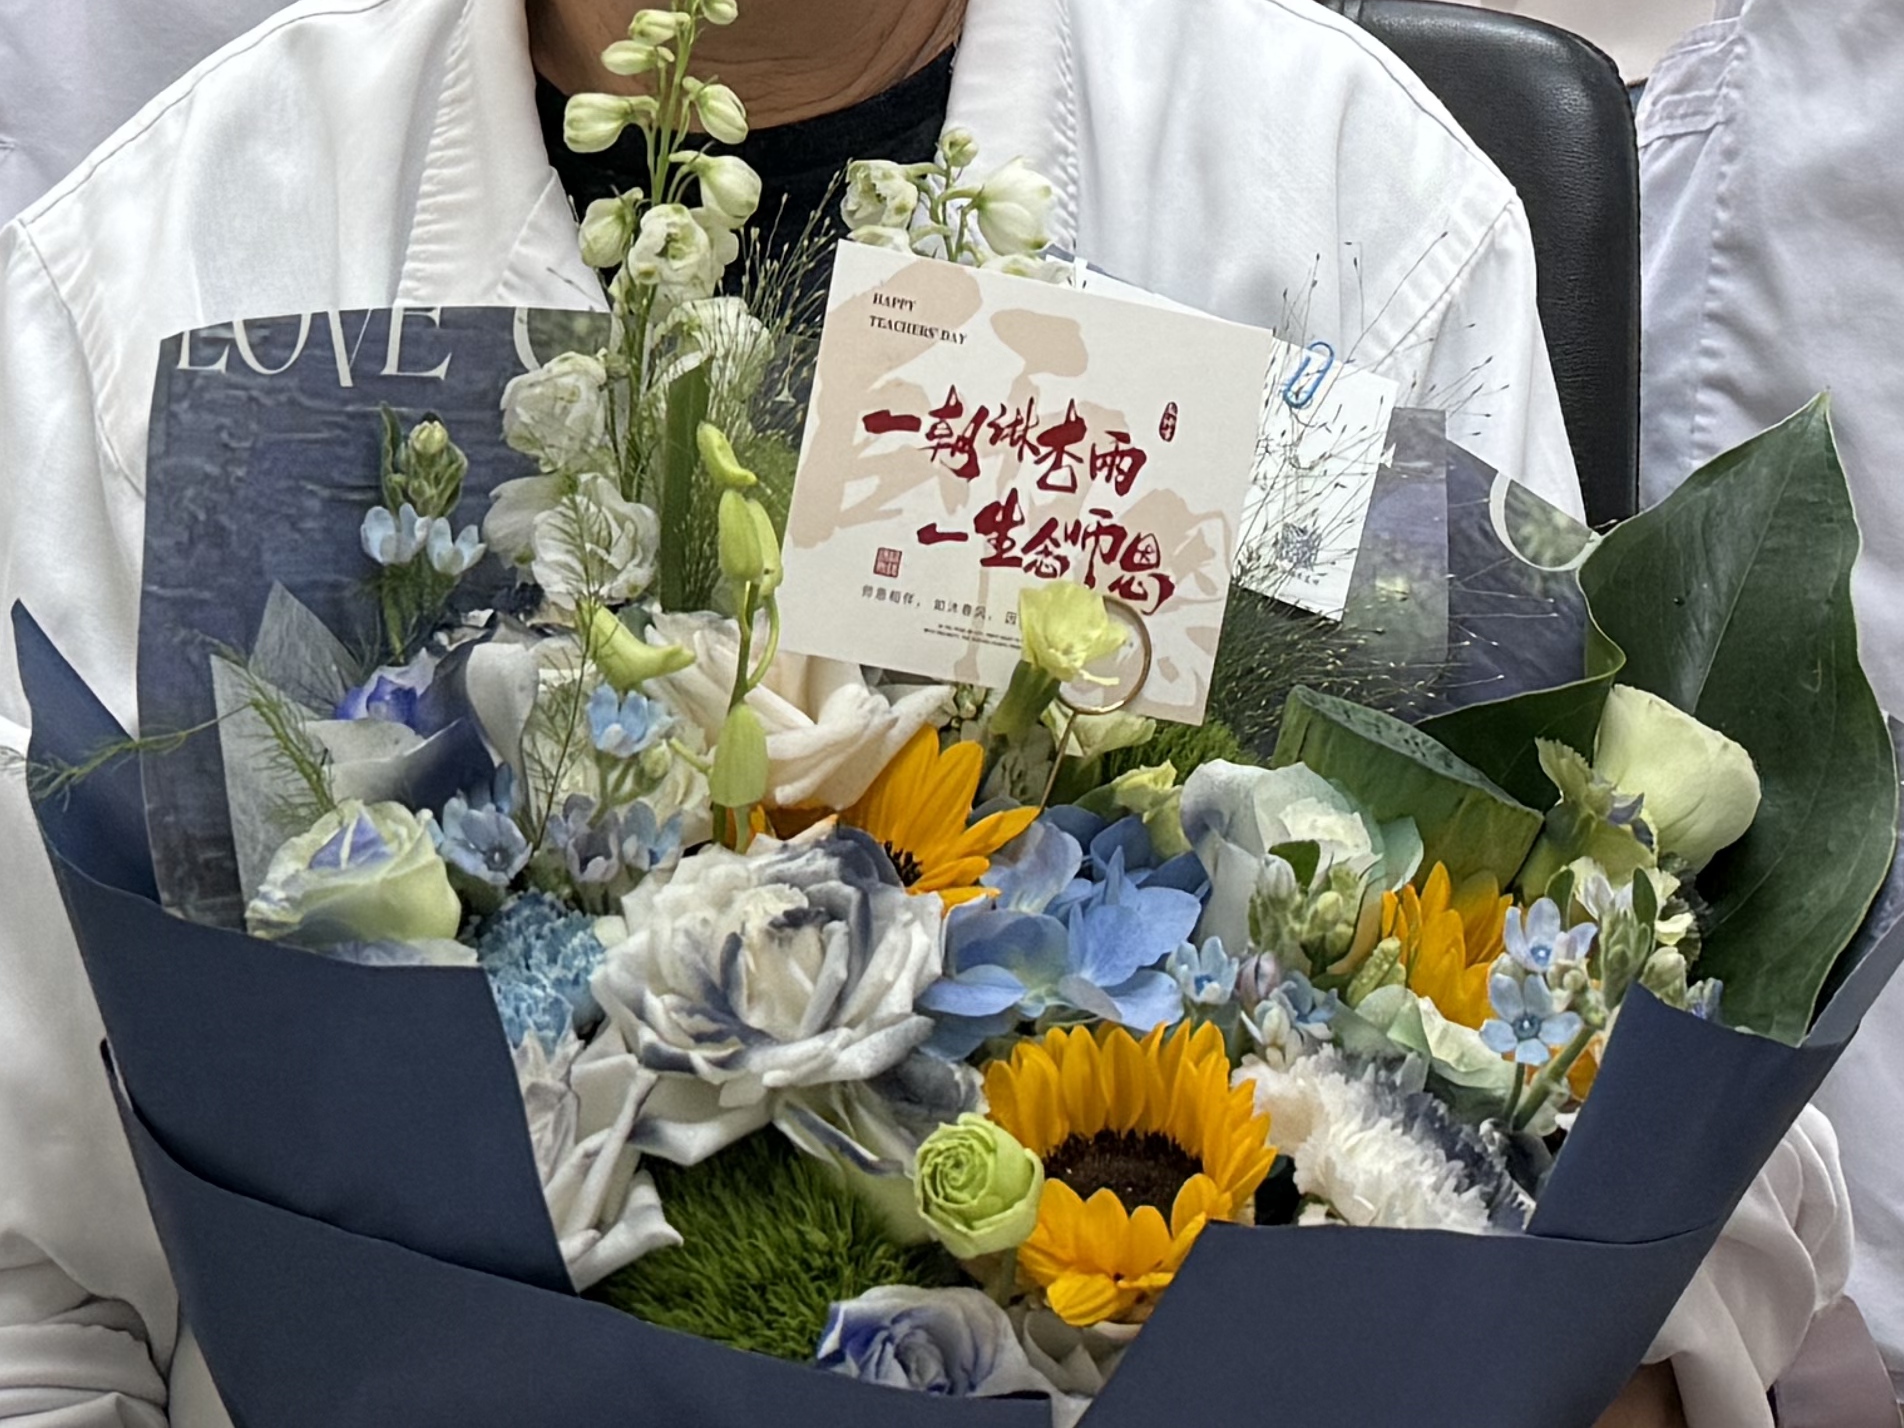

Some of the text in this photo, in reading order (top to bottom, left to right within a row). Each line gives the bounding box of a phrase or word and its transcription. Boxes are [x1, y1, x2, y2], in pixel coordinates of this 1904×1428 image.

[873, 292, 917, 312] HAPPY
[939, 328, 968, 346] DAY
[916, 487, 1176, 616] 一生念师恩
